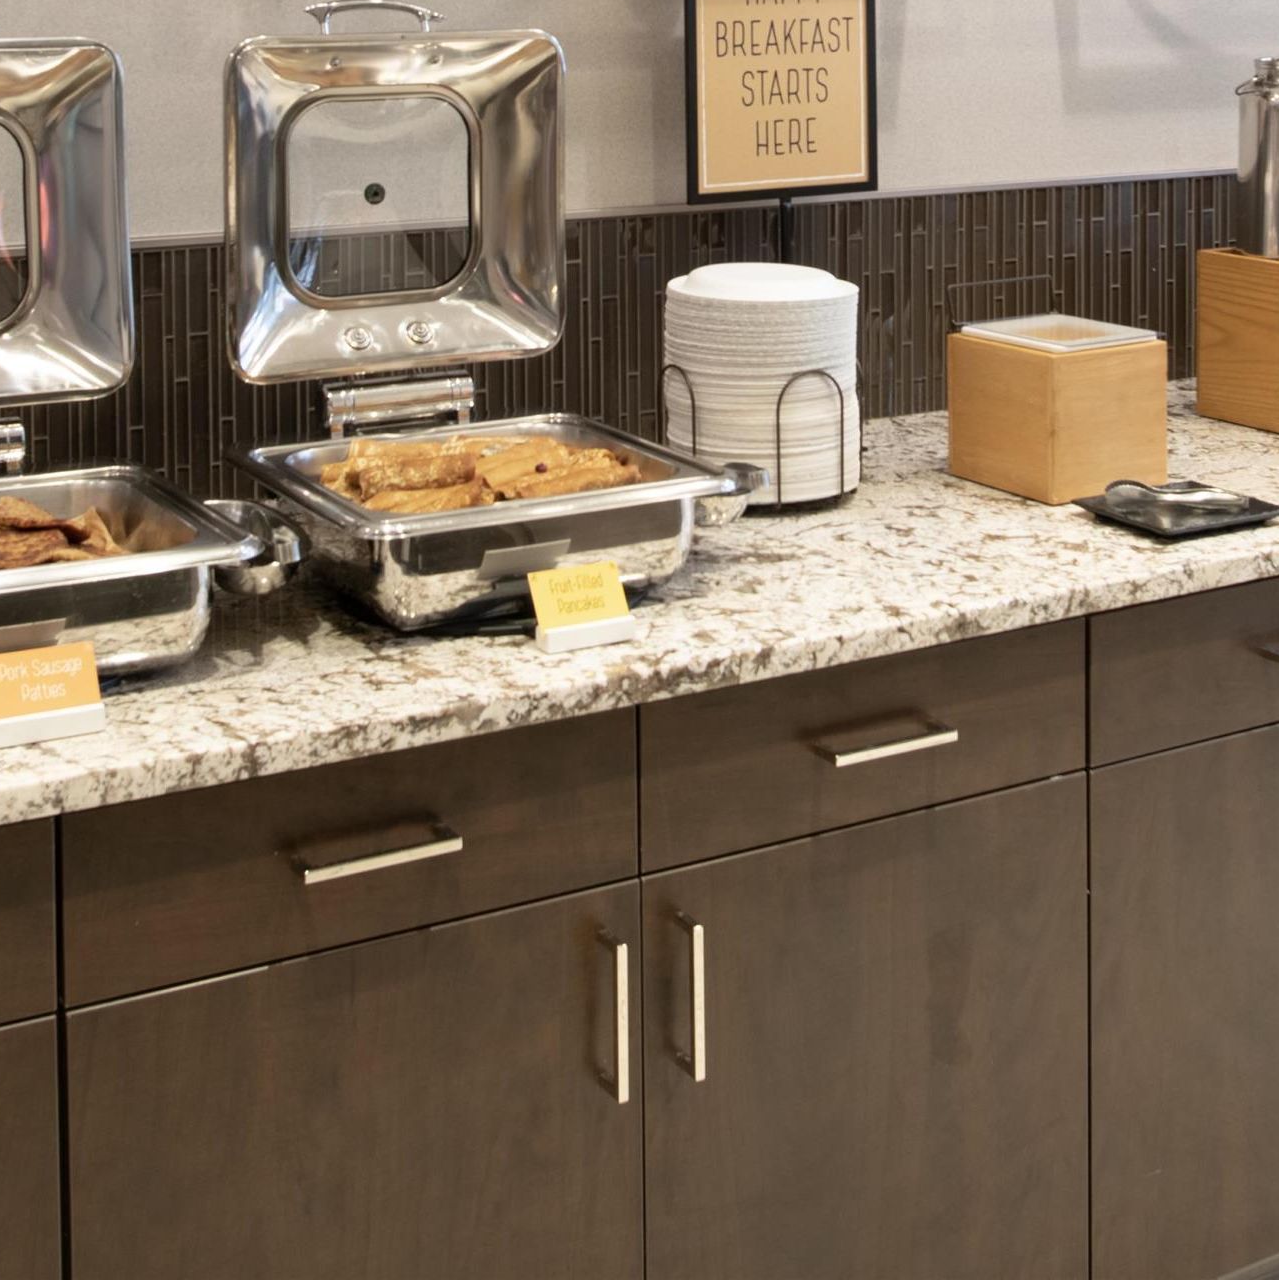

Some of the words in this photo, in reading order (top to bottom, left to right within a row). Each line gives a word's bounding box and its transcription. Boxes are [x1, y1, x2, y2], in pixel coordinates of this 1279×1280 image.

[715, 16, 854, 58] BREAKFAST
[741, 67, 829, 107] STARTS
[755, 117, 817, 157] HERE
[31, 656, 83, 678] Sausage
[21, 682, 67, 702] Patties
